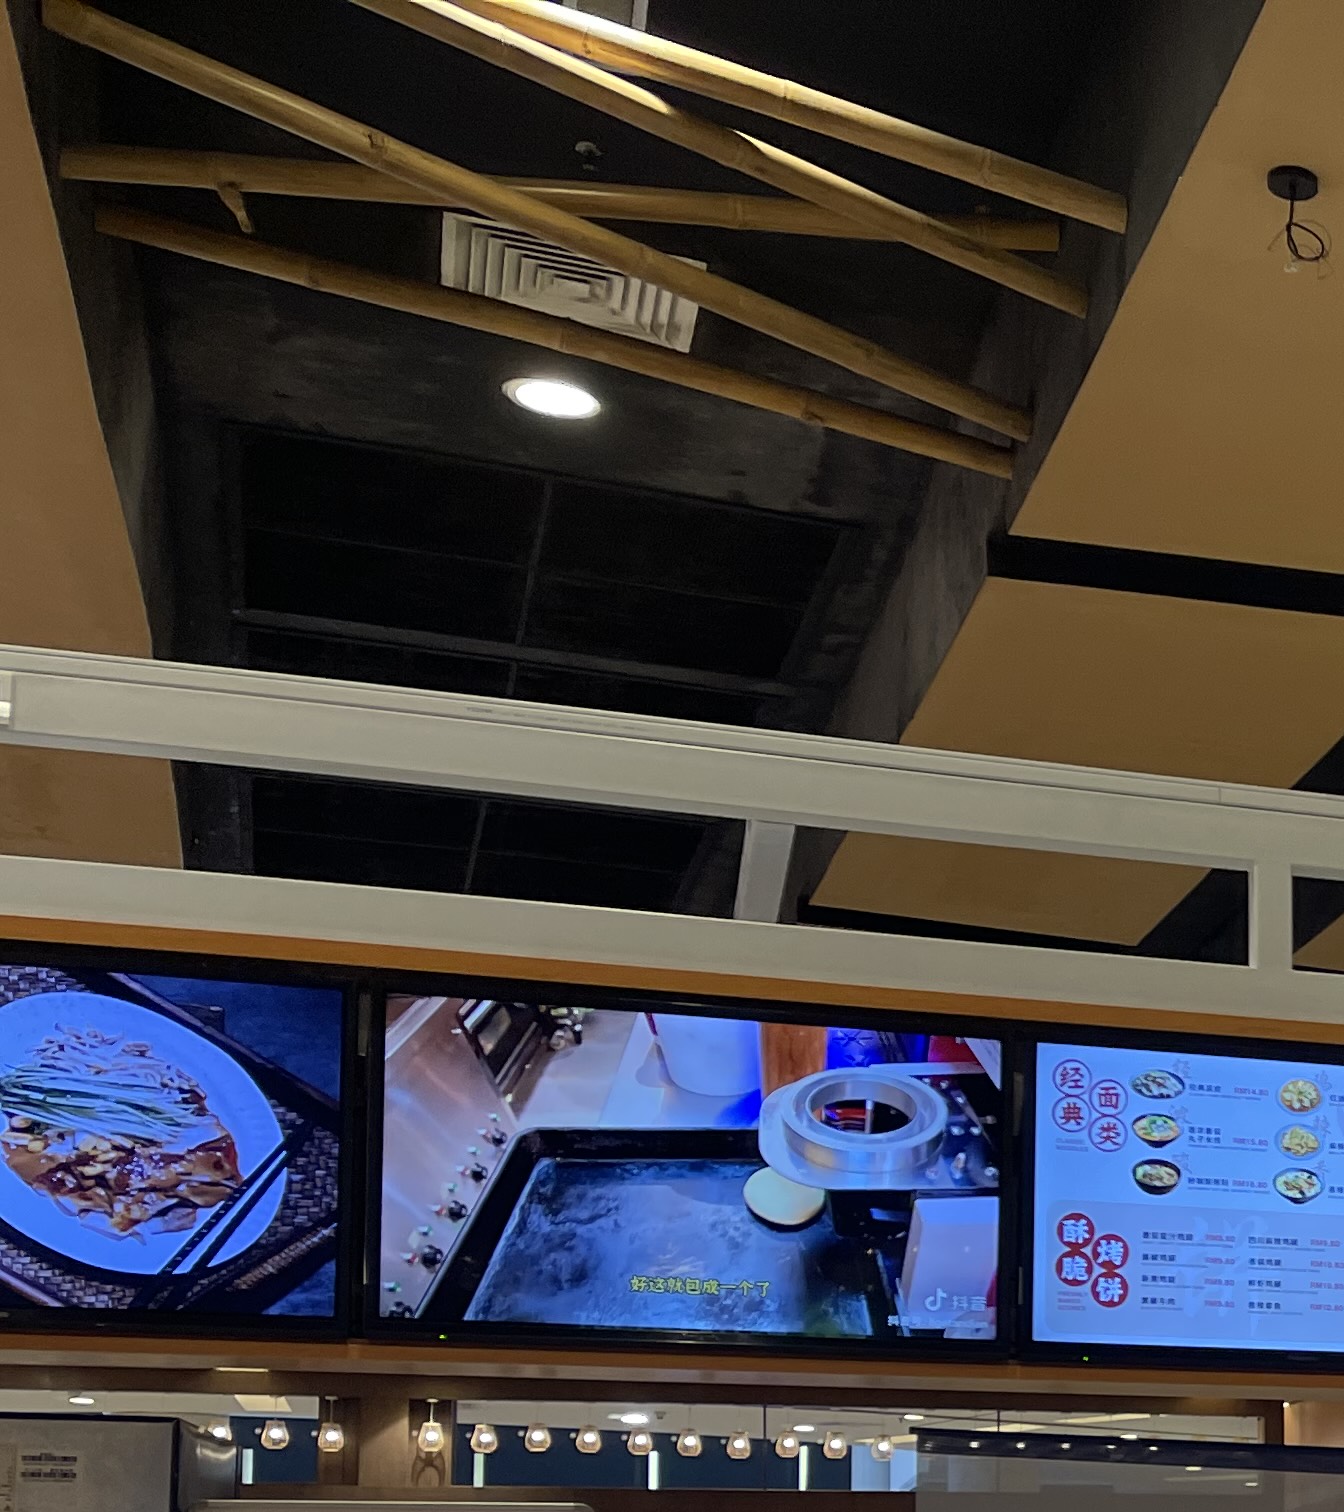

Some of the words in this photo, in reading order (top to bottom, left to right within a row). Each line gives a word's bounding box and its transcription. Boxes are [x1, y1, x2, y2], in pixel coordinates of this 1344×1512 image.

[630, 1275, 770, 1298] 好这就包成一个了
[952, 1295, 987, 1312] 抖音
